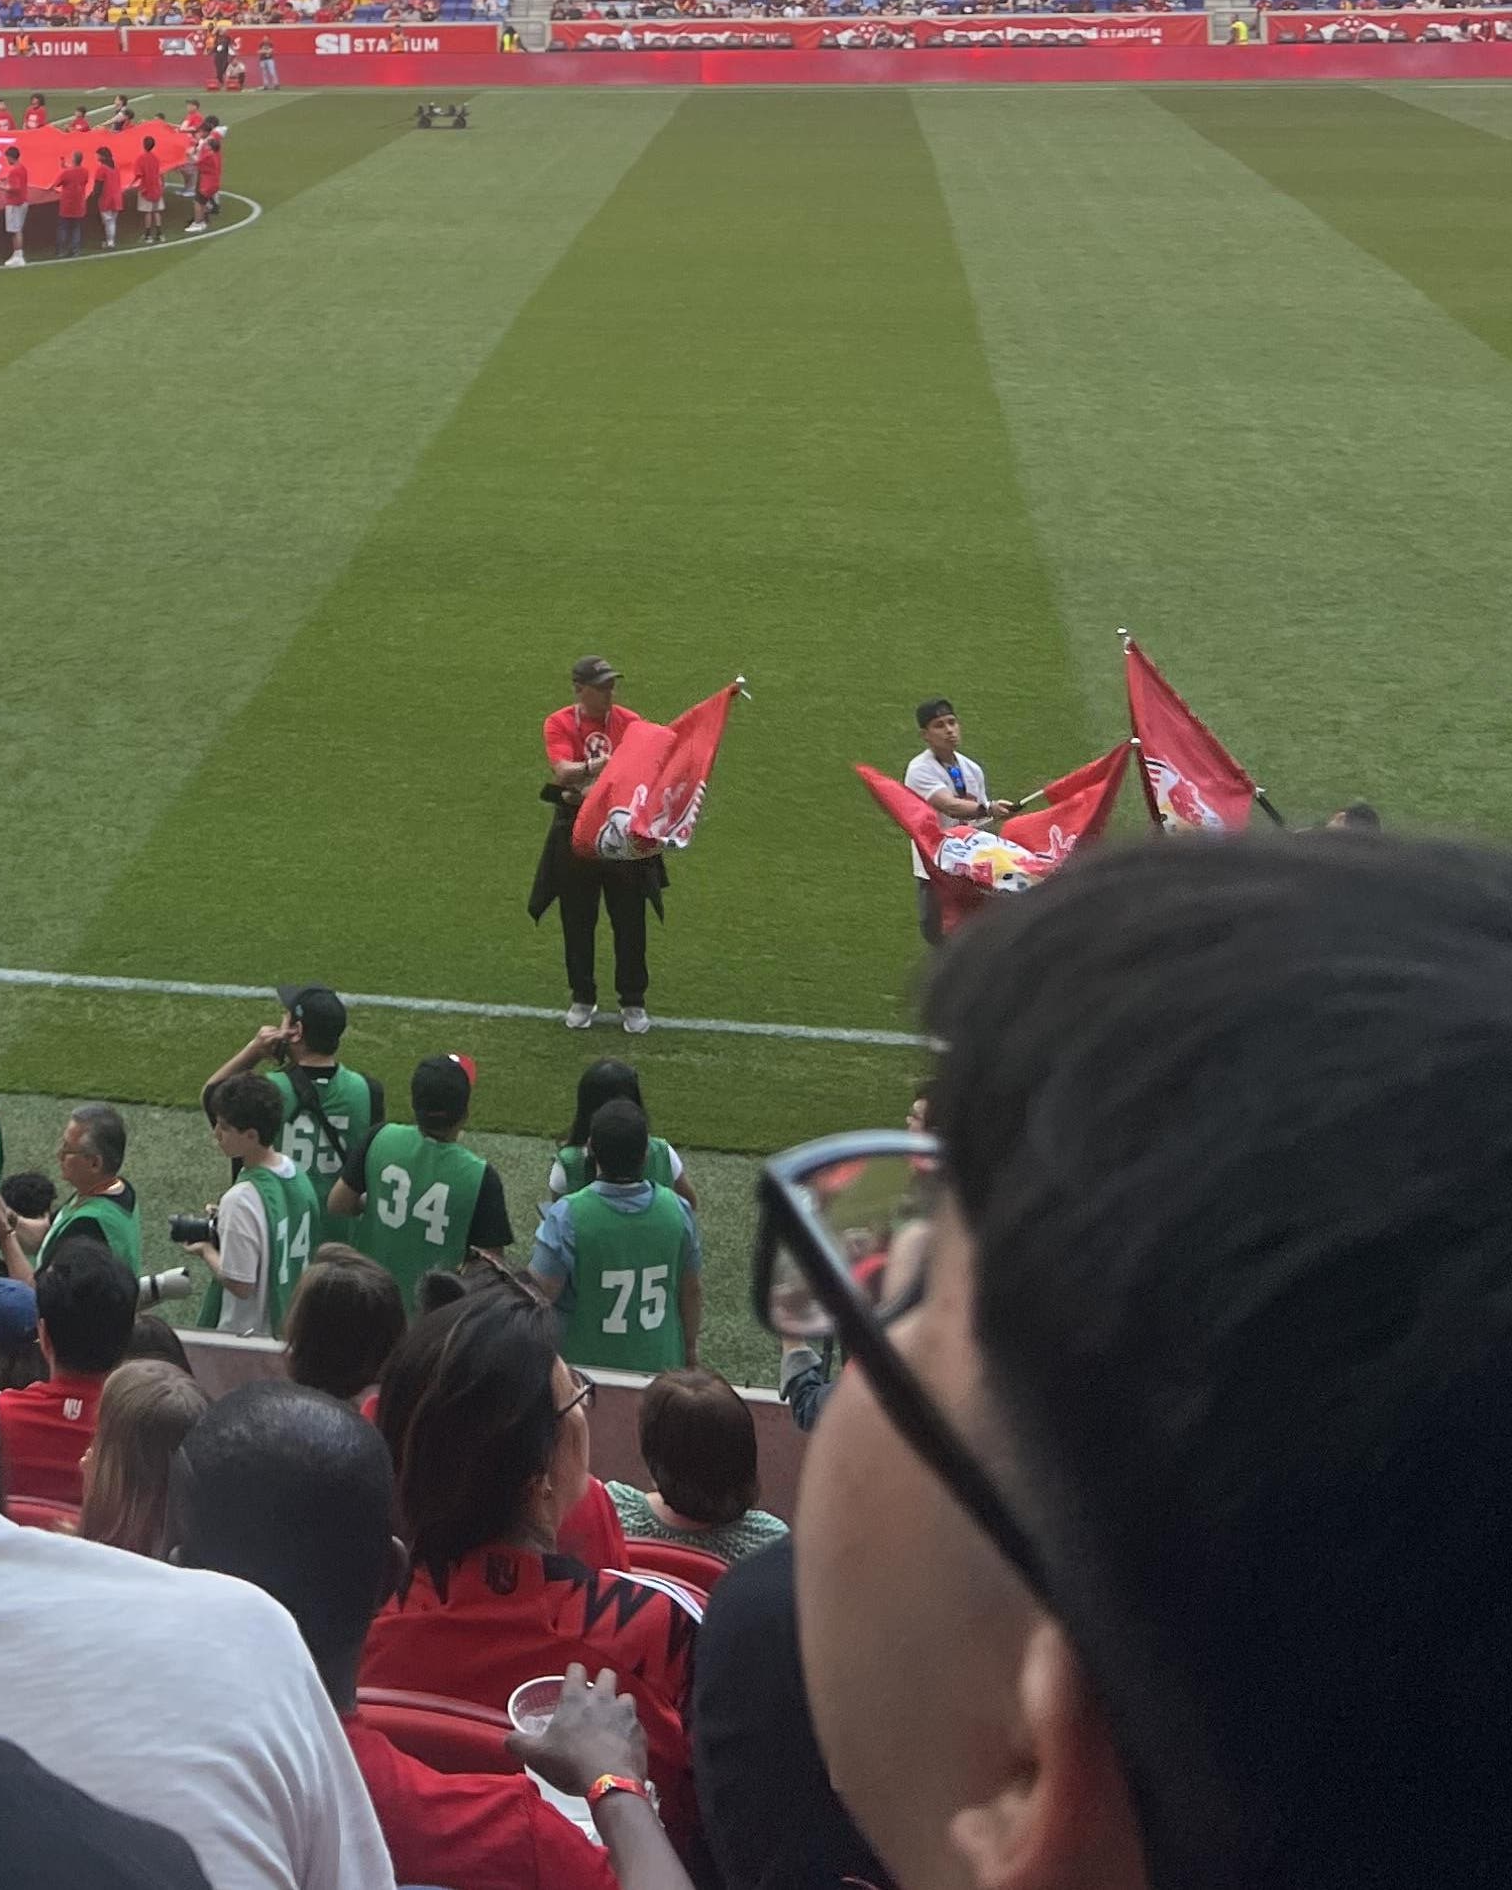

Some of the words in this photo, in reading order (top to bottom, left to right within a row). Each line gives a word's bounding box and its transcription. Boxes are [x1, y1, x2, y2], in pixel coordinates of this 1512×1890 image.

[8, 41, 88, 56] SADIUM
[315, 33, 351, 55] SI
[353, 37, 439, 53] STAIUM
[281, 1114, 350, 1175] 65
[377, 1163, 450, 1246] 34
[600, 1263, 669, 1334] 75
